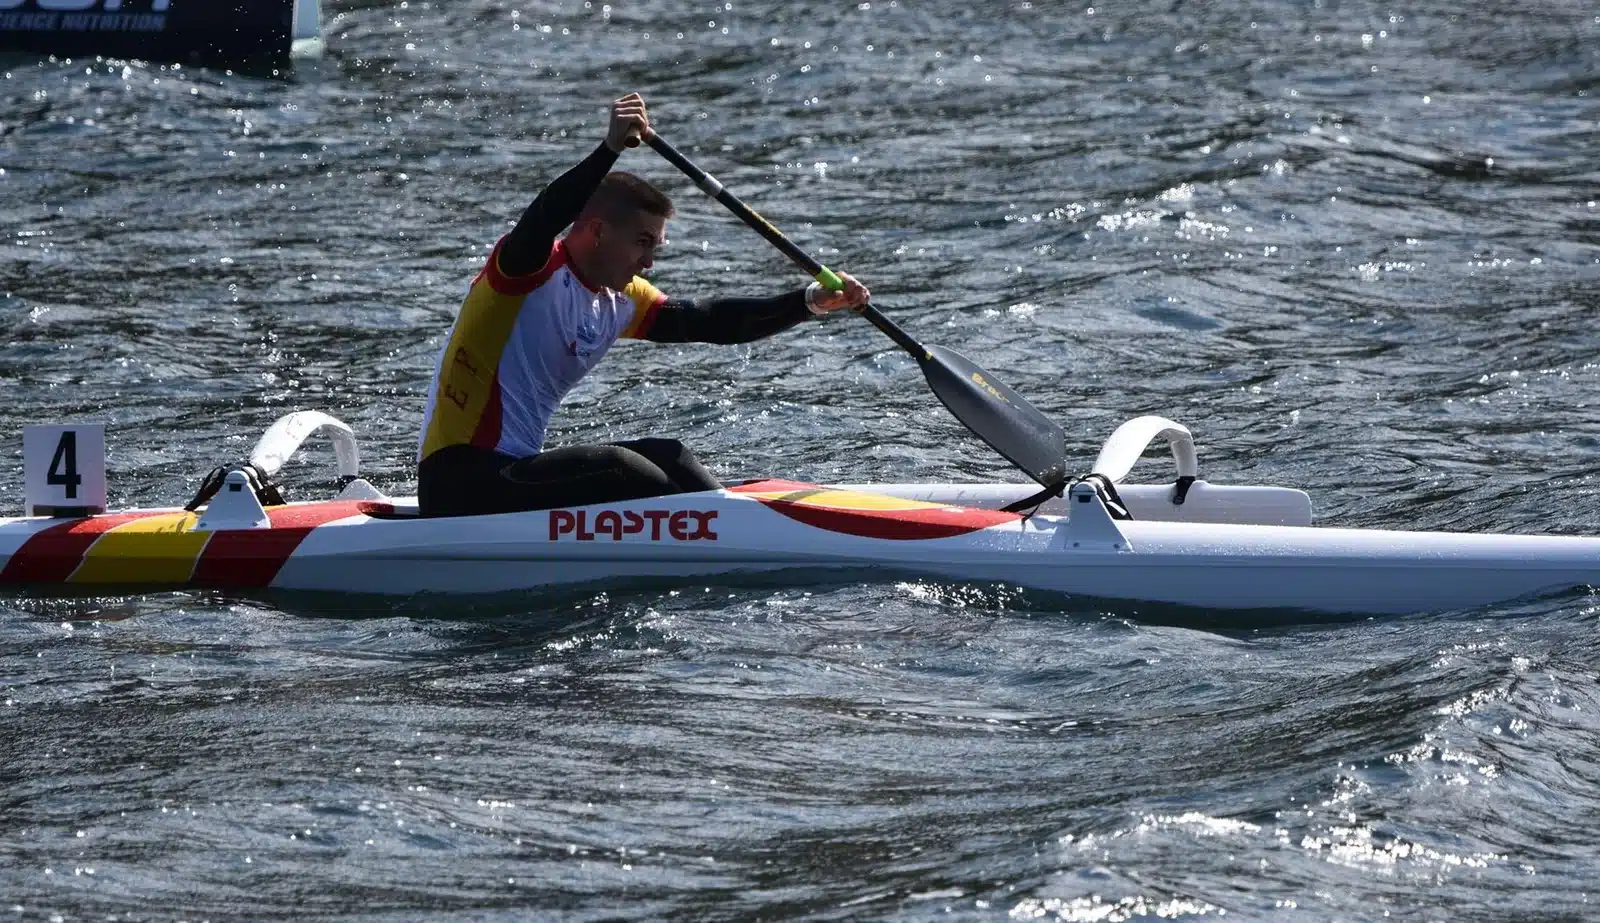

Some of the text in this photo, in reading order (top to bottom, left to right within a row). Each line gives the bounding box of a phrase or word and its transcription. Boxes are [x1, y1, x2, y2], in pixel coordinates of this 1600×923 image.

[61, 12, 166, 30] NUTRITION
[46, 430, 82, 499] 4
[549, 510, 718, 541] PLASTEX
